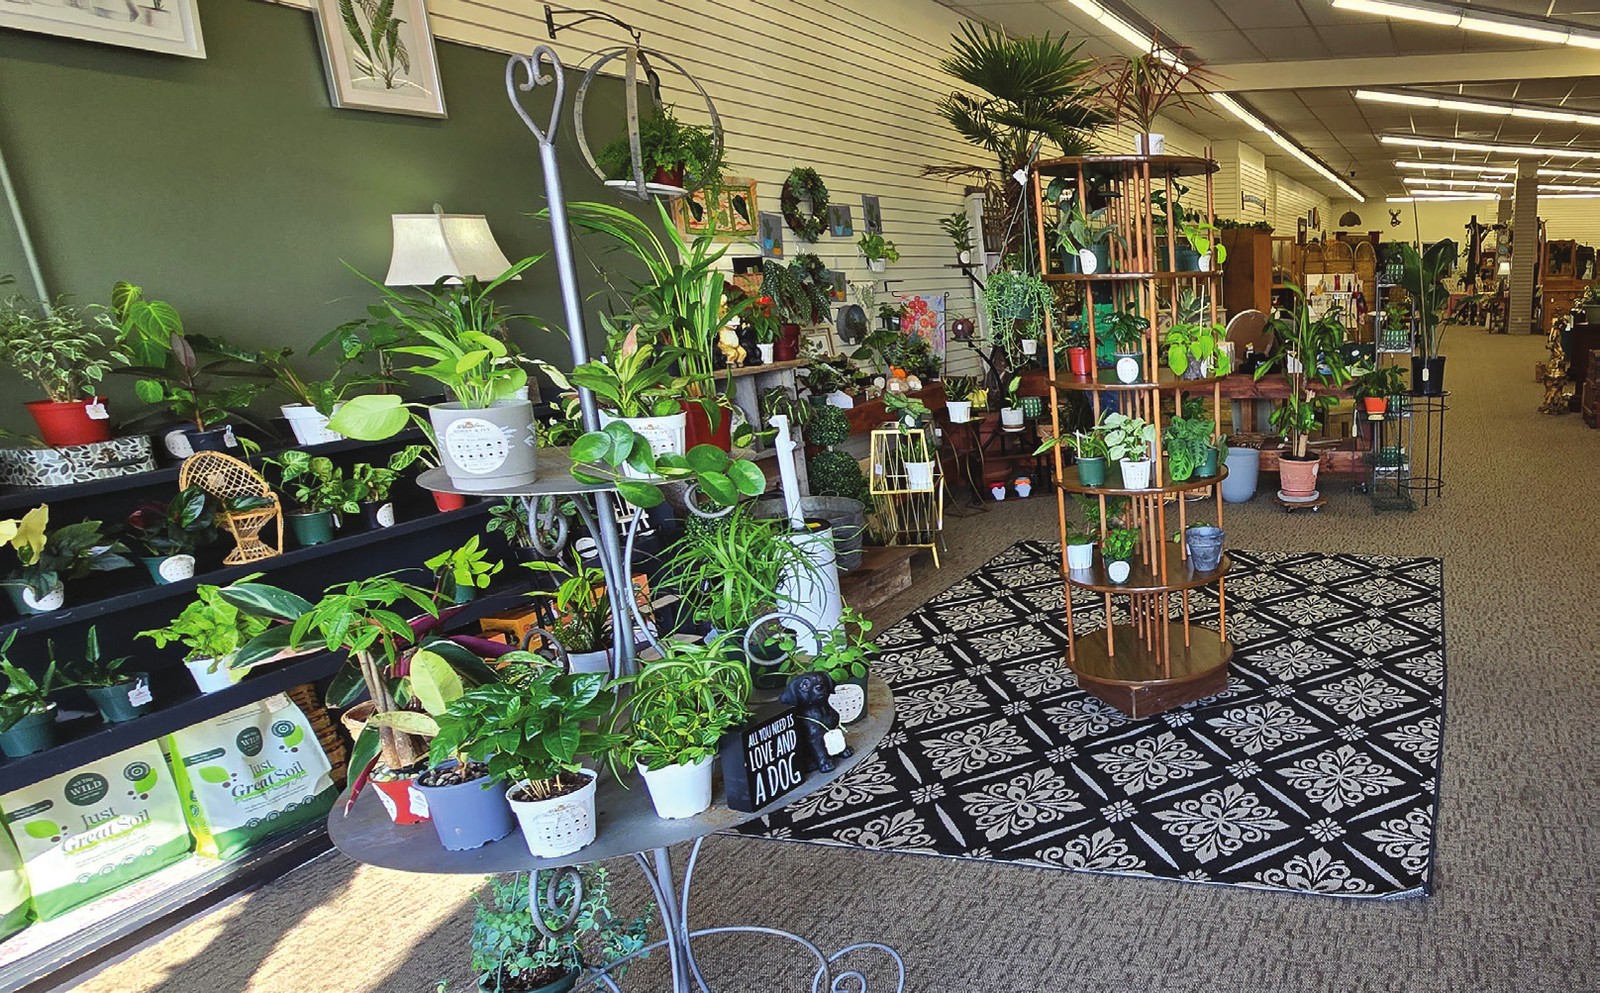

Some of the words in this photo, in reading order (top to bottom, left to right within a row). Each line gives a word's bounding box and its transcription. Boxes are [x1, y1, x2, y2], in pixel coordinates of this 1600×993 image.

[748, 734, 758, 748] ALL
[759, 727, 771, 741] YOU
[772, 718, 786, 735] NEED
[787, 714, 794, 728] IS
[749, 740, 775, 772] LOVE
[776, 729, 797, 758] AND
[231, 774, 274, 798] Great
[274, 760, 305, 782] Soil
[249, 759, 273, 779] Just
[756, 772, 766, 805] A
[767, 752, 801, 796] DOG
[69, 780, 103, 796] WILD
[62, 824, 114, 852] Great
[117, 809, 150, 830] Soil
[81, 806, 117, 830] Just
